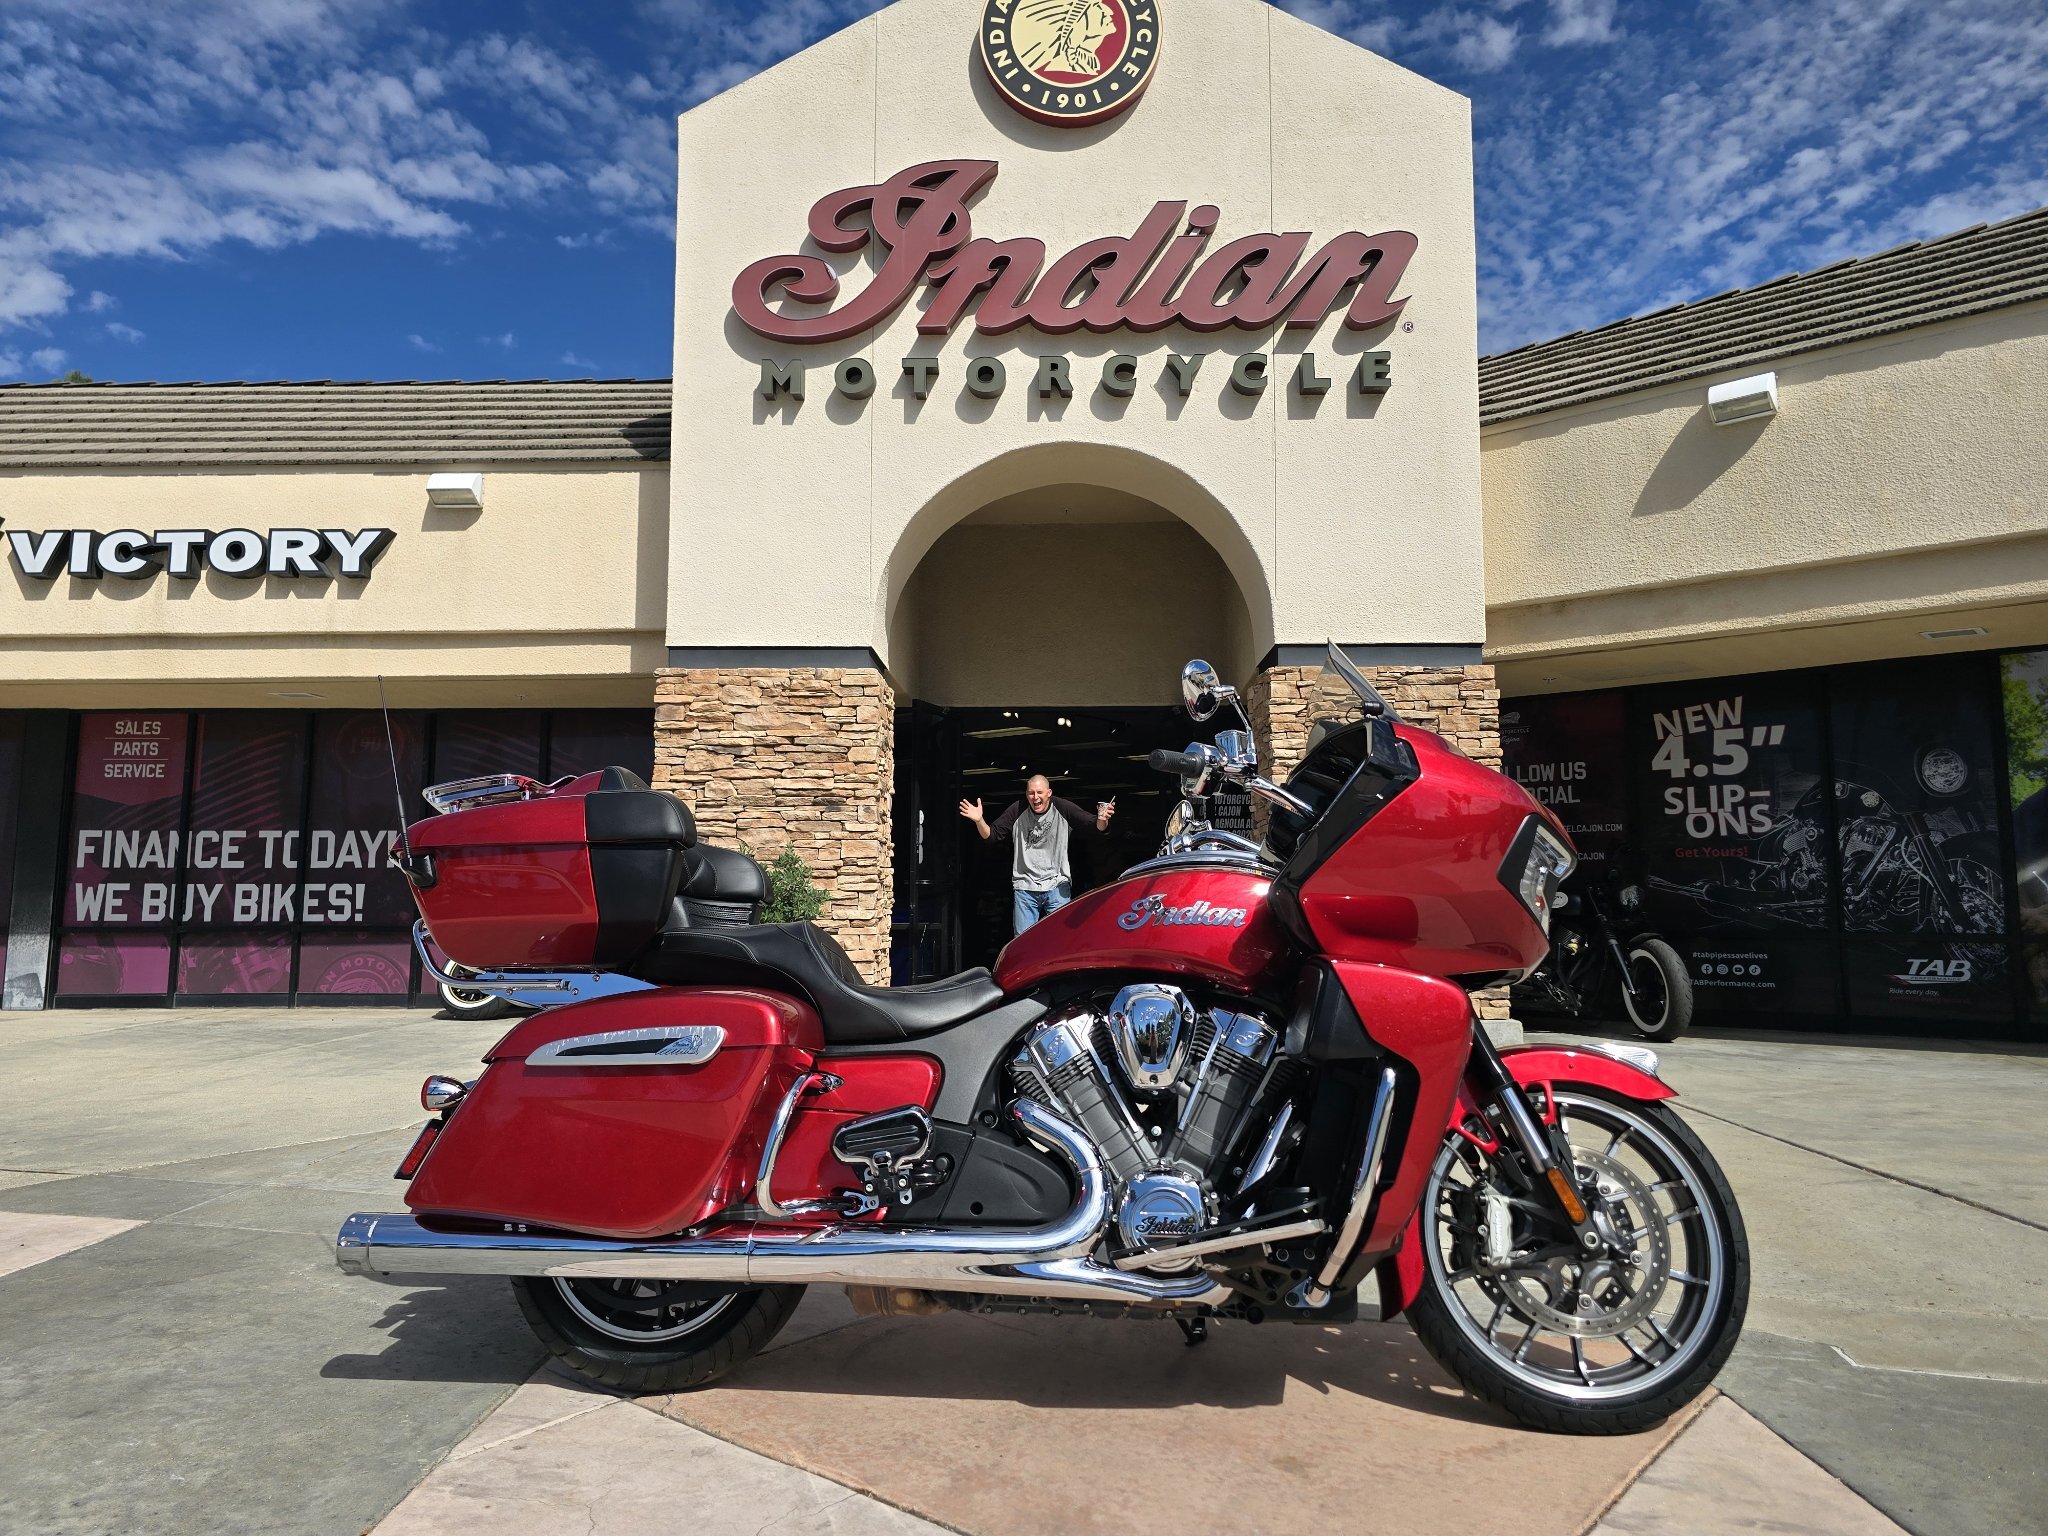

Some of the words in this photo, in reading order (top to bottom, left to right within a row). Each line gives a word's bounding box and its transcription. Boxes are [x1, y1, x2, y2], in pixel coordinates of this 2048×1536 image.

[1041, 89, 1102, 108] 1901
[731, 159, 1418, 345] Indian
[760, 351, 1391, 400] MOTORCYCLE
[6, 528, 396, 579] VICTORY
[1652, 696, 1743, 740] NEW
[115, 721, 162, 735] SALES
[113, 742, 159, 756] PARTS
[104, 764, 166, 778] SERVICE
[1560, 761, 1587, 781] US
[1214, 818, 1244, 828] AGNOLIA
[1565, 823, 1623, 833] ELCAJON.COM
[1685, 804, 1773, 838] ONS
[76, 830, 245, 868] FINANCE
[1577, 852, 1605, 861] CAJON
[1675, 847, 1701, 858] Get
[1704, 846, 1748, 858] Yours!
[75, 883, 131, 922] WE
[141, 883, 224, 922] BUY
[232, 883, 366, 922] BIKES!
[1117, 893, 1247, 931] Indian
[1692, 951, 1768, 960] #tabpipessavelives
[1906, 958, 1972, 981] TAB
[1689, 979, 1776, 989] TABPerformance.com
[1905, 989, 1924, 997] every
[1135, 1215, 1195, 1235] Indian
